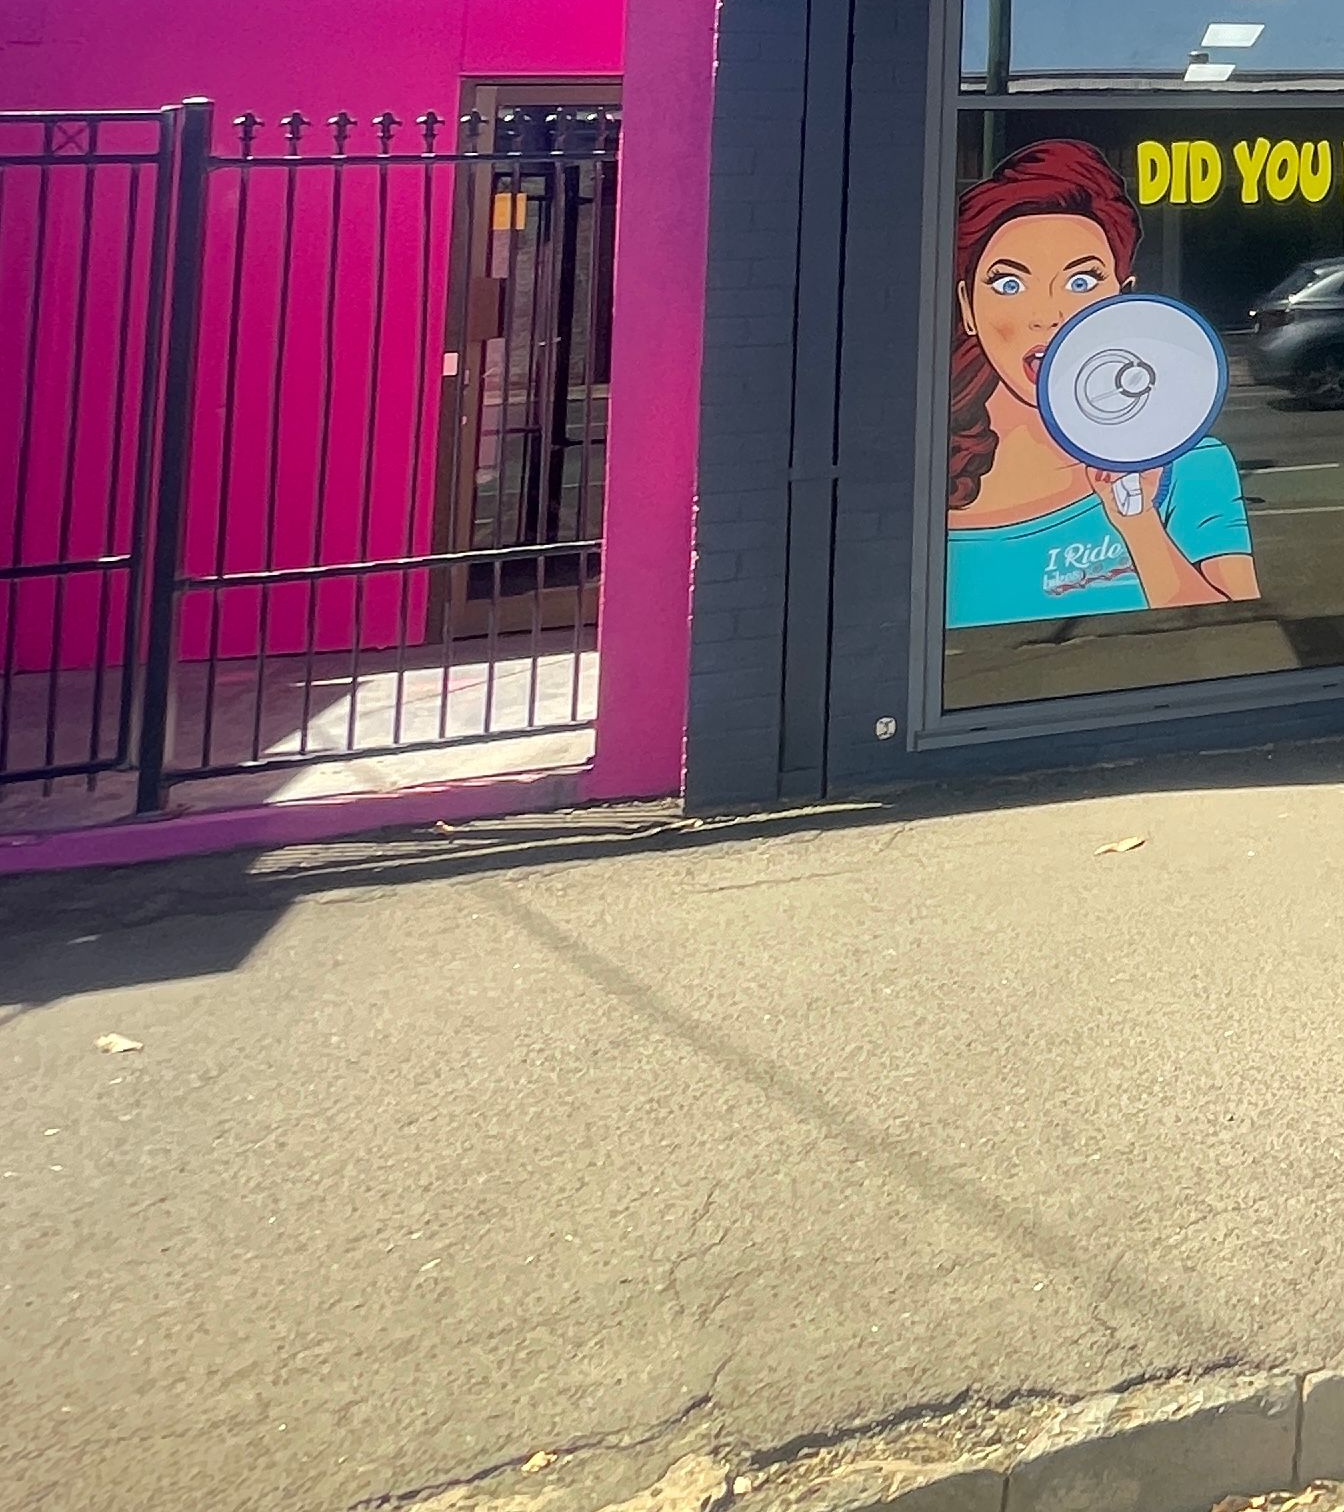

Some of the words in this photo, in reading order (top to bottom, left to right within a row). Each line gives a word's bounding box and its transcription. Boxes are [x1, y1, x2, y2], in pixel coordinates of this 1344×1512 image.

[1137, 140, 1222, 204] DID
[1233, 137, 1333, 204] YOU
[1044, 548, 1061, 572] I
[1064, 534, 1123, 568] Ride
